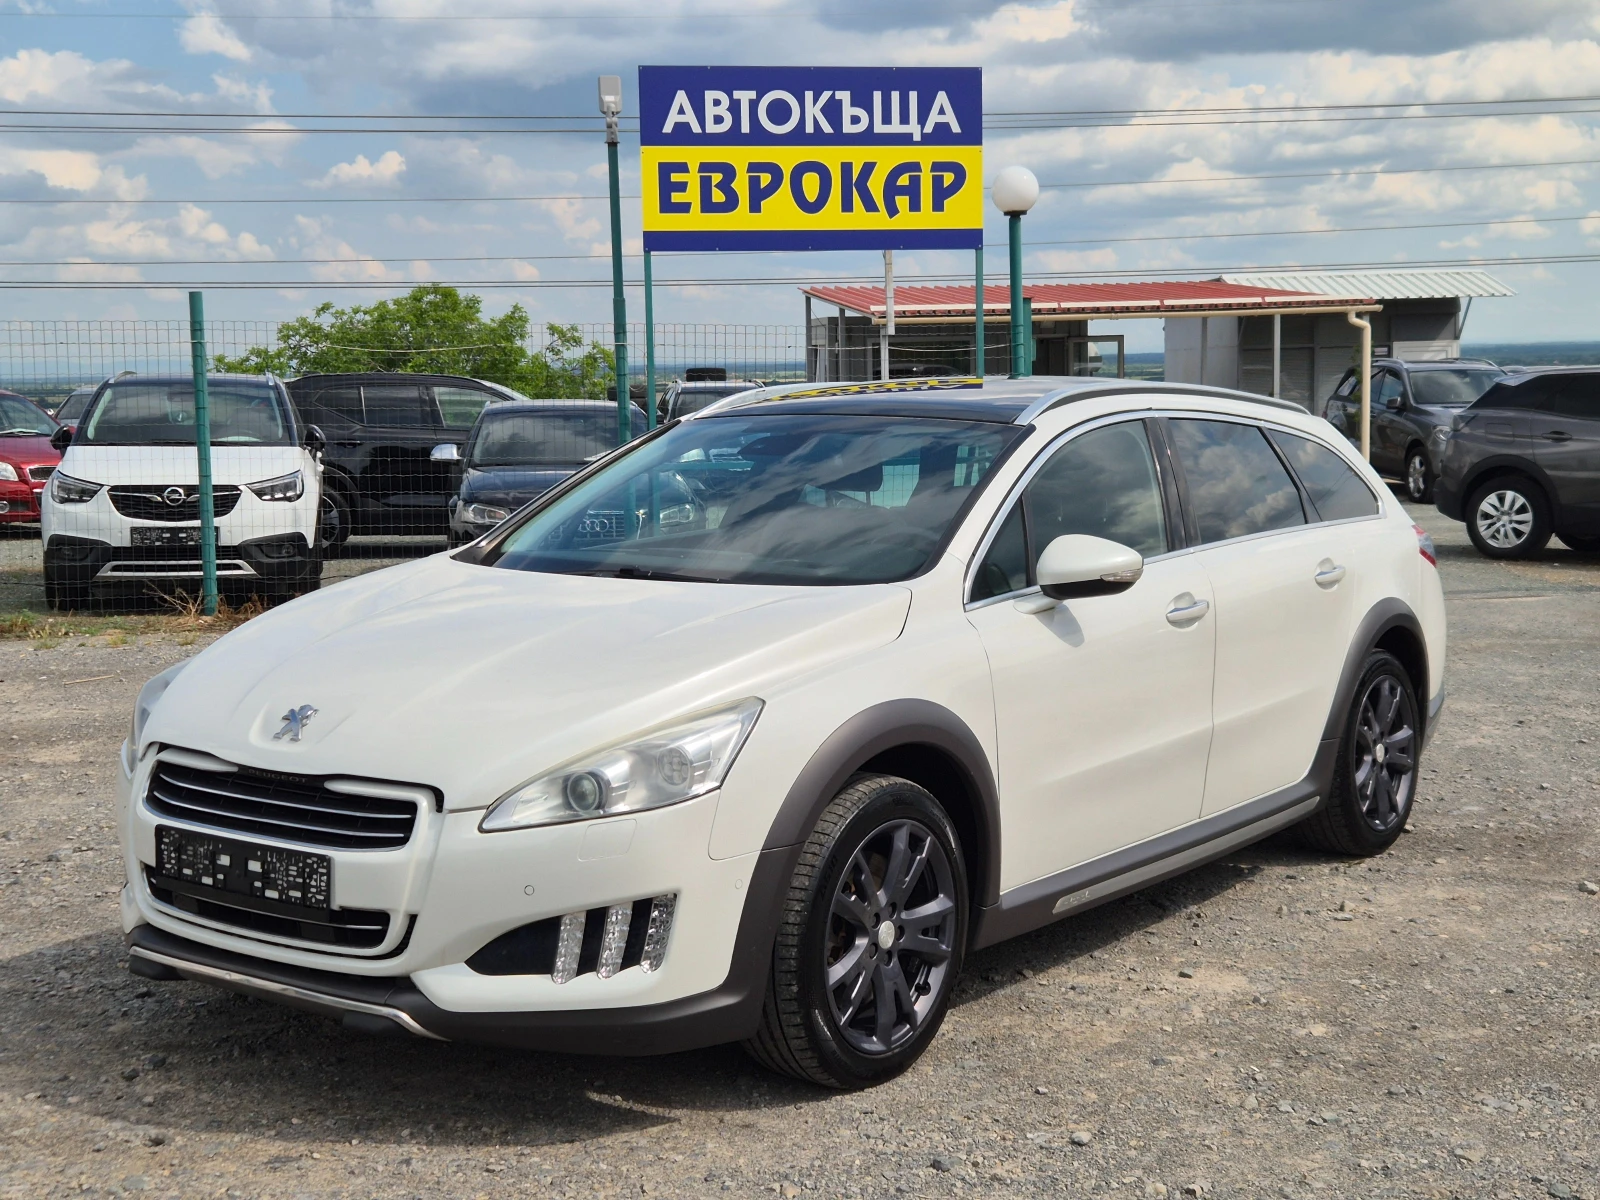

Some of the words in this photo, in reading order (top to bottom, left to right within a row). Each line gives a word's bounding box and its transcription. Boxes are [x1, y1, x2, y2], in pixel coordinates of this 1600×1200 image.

[662, 90, 961, 141] АВТОКЪЩА
[658, 160, 966, 219] ЕВРОКАР
[248, 769, 307, 783] PEUGEOT
